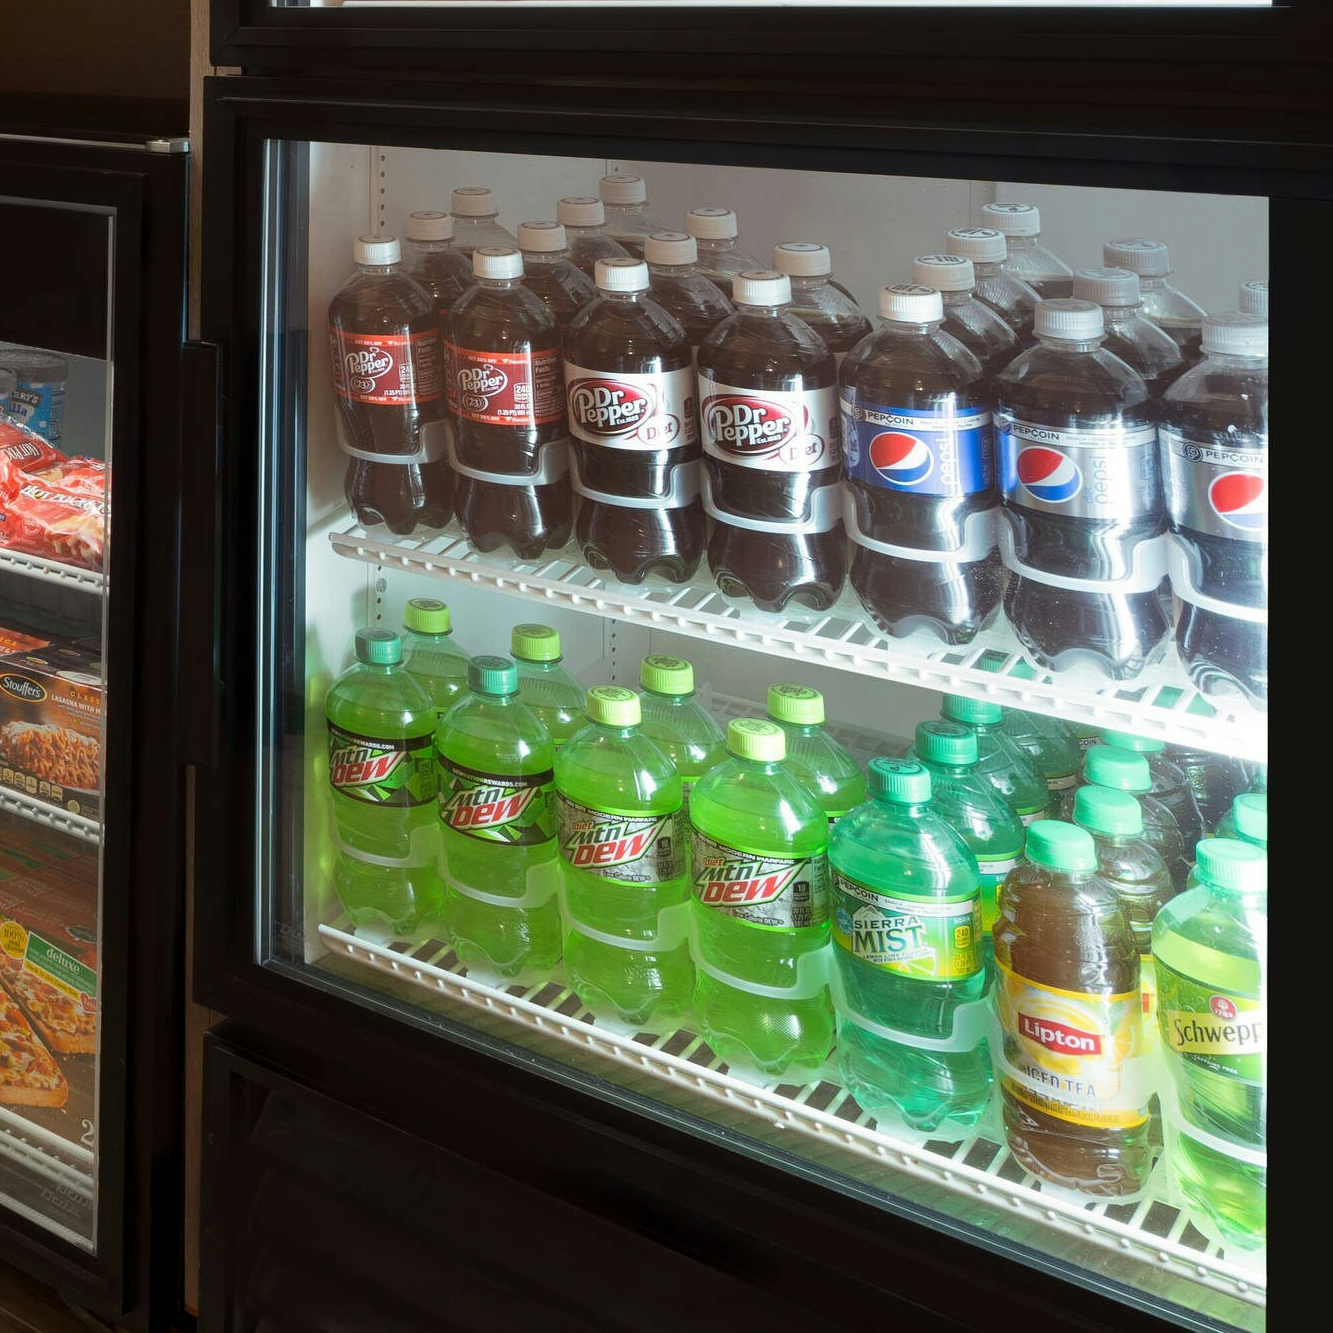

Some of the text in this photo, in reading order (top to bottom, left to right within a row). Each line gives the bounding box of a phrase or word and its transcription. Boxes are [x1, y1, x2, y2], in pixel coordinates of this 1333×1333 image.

[345, 352, 390, 376] Pepper
[357, 351, 378, 363] Dr
[457, 368, 505, 393] Pepper
[472, 367, 490, 380] Dr
[594, 387, 625, 407] Dr
[576, 389, 648, 428] Pepper
[732, 404, 767, 426] Dr
[867, 410, 914, 426] PEPCOIN
[709, 405, 792, 446] Pepper
[1012, 423, 1060, 442] PEPCOIN
[938, 429, 958, 487] pepsi
[1205, 450, 1264, 465] PEPCOIN
[1095, 454, 1109, 505] pepsi
[2, 676, 42, 699] Stouffer's
[50, 694, 95, 713] LASAGNA WITH
[572, 820, 593, 831] diet
[704, 856, 724, 867] diet
[718, 844, 795, 865] MODERN WARFARE
[839, 877, 879, 903] PEPCOIN
[854, 916, 920, 930] SIERRA
[854, 925, 923, 954] MIST
[46, 948, 81, 975] deluxe
[1024, 1018, 1095, 1052] Lipton
[1174, 1018, 1263, 1046] Schwepp
[1065, 1078, 1097, 1098] TEA
